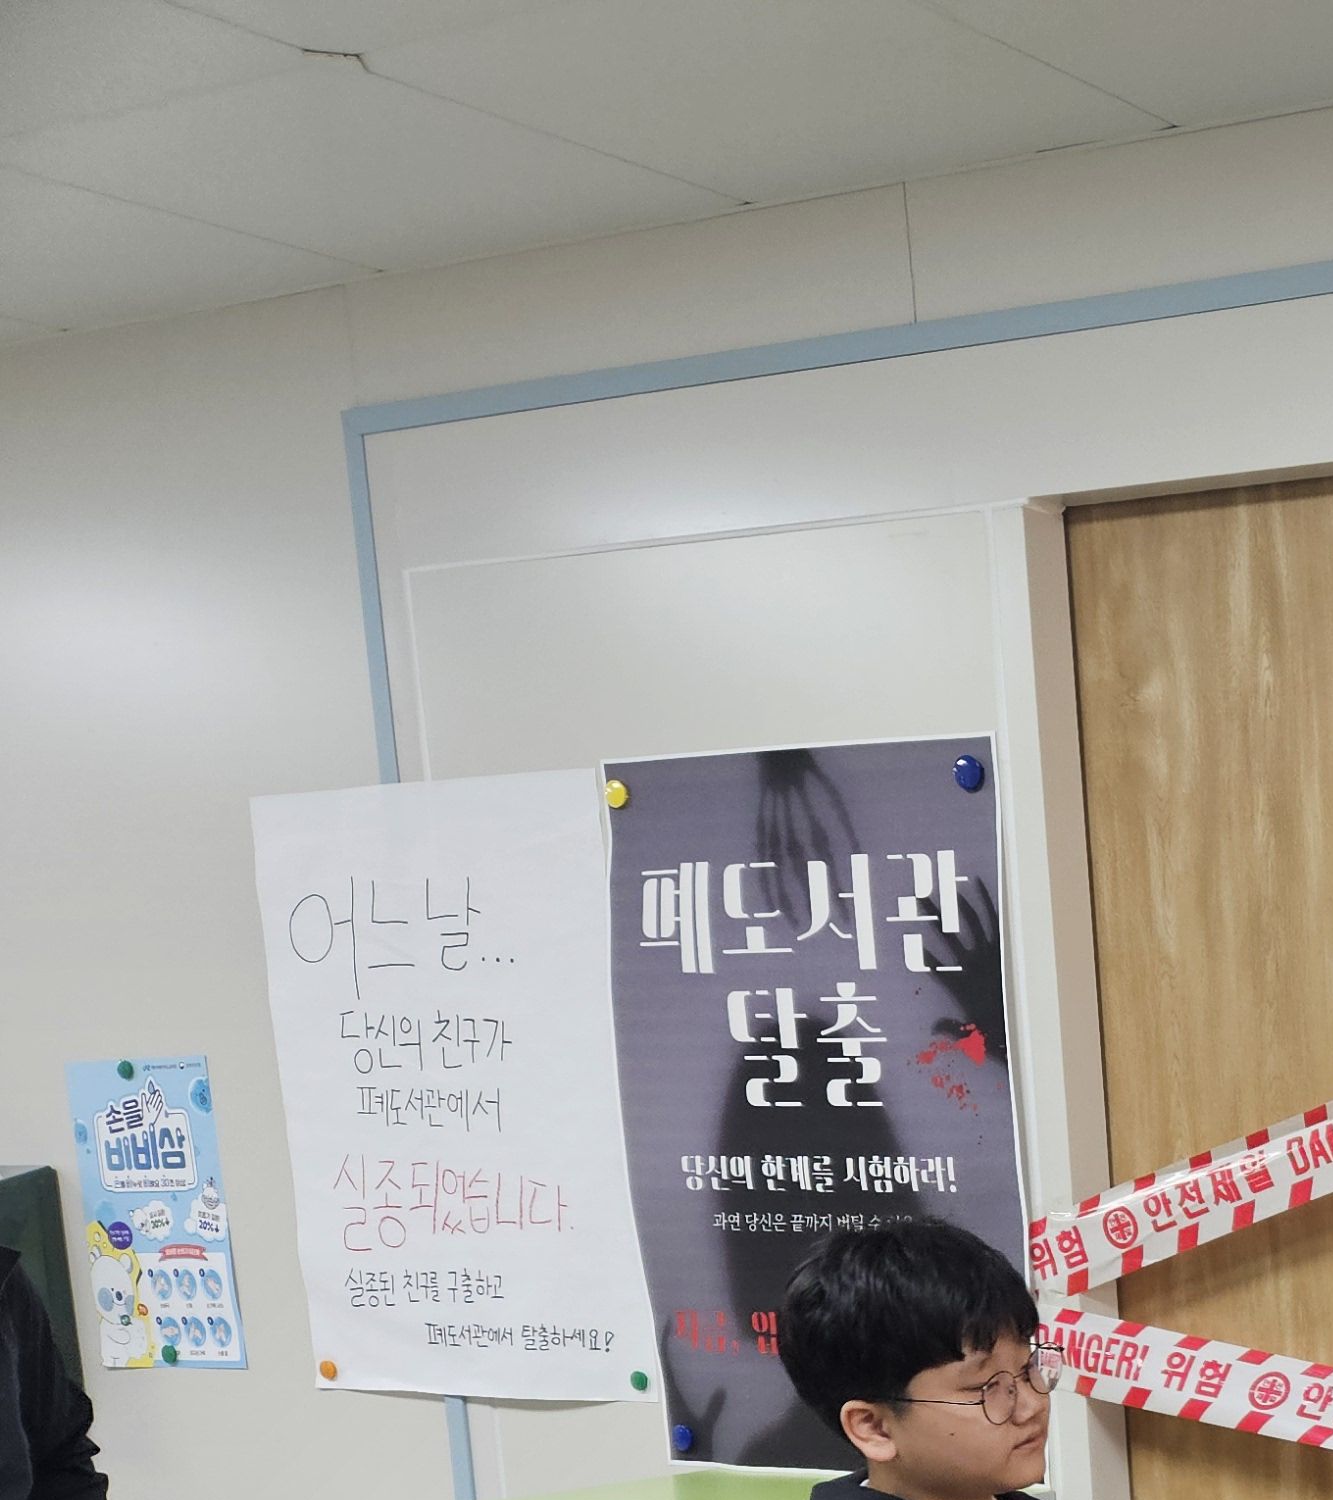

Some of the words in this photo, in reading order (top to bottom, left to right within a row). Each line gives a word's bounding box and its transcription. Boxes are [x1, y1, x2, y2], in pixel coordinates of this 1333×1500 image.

[640, 850, 968, 974] 폐도서관
[289, 876, 415, 1001] 어느
[340, 1010, 423, 1074] 당신의
[432, 1010, 512, 1070] 친구가
[727, 982, 888, 1107] 탈출
[105, 1098, 143, 1134] 손을
[357, 1086, 502, 1132] 폐도서관에서
[104, 1123, 186, 1171] 비비삼
[681, 1155, 755, 1191] 당신의
[761, 1155, 835, 1192] 한계를
[843, 1155, 957, 1193] 시험하라!
[712, 1213, 741, 1231] 과연
[745, 1213, 787, 1233] 당신은
[790, 1213, 832, 1232] 끝까지
[1029, 1225, 1089, 1281] 위험
[1142, 1150, 1274, 1234] 안전제일
[345, 1267, 396, 1307] 실종된
[403, 1269, 440, 1303] 친구를
[447, 1267, 504, 1304] 구출하고
[521, 1323, 614, 1353] 탈출하세요!
[1161, 1351, 1232, 1399] 위험
